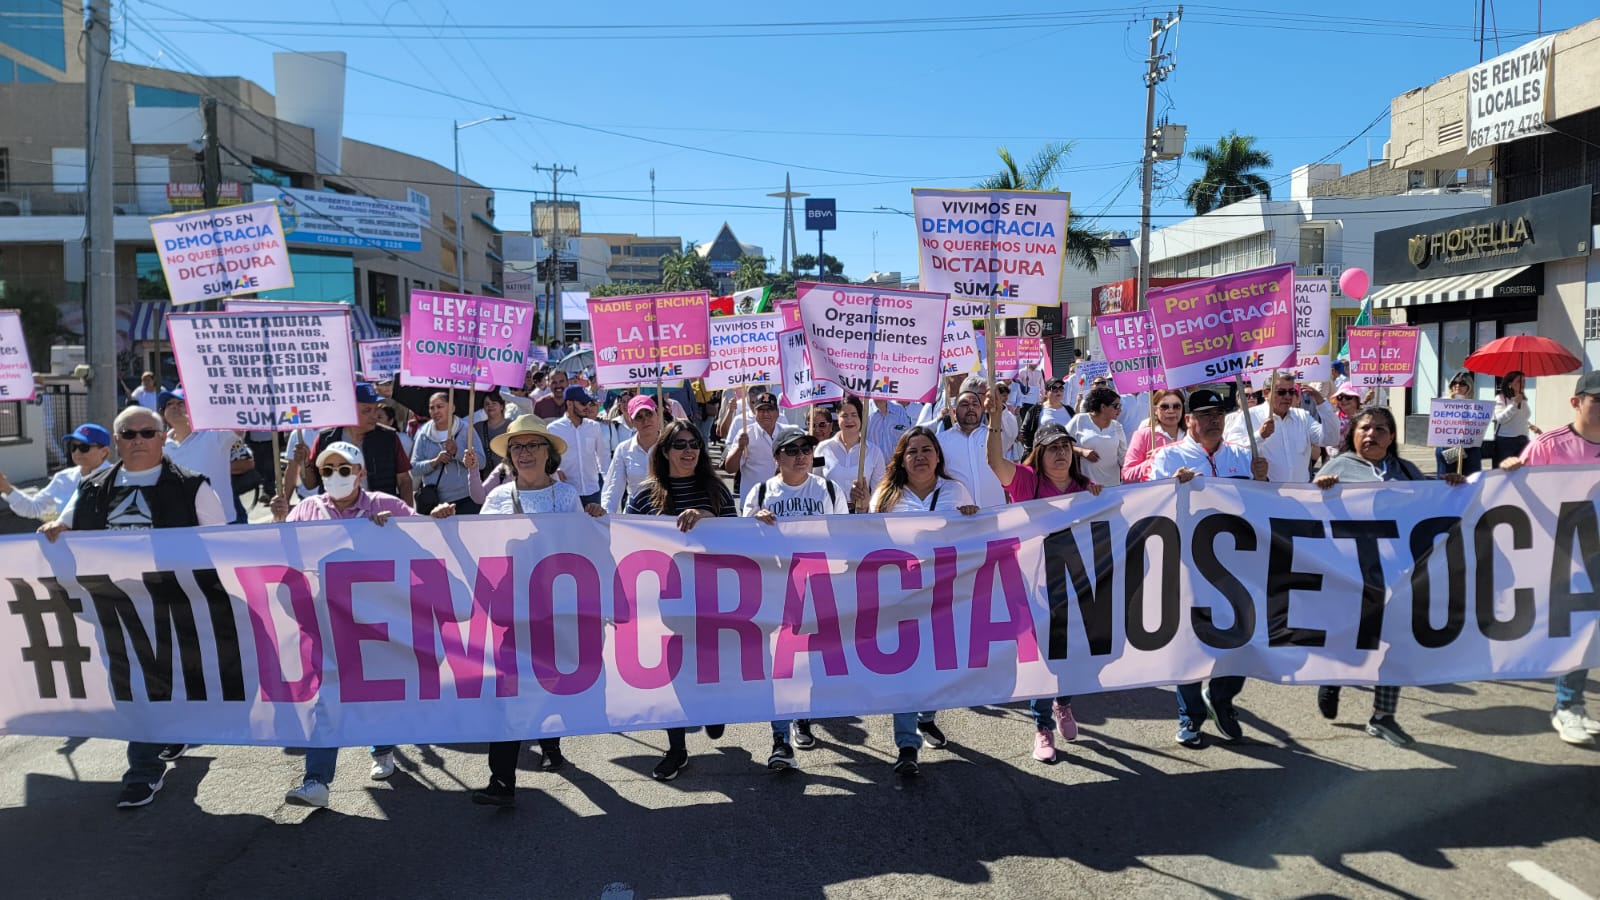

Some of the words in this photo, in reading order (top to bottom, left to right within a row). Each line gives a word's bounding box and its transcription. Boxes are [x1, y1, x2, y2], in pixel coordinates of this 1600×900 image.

[1472, 69, 1488, 93] SE
[1493, 45, 1550, 86] RENTAN
[1478, 79, 1541, 118] LOCALES
[1471, 126, 1490, 148] 667
[1494, 120, 1515, 142] 372
[943, 201, 1010, 215] VIVIMOS
[1015, 203, 1037, 216] EN
[176, 217, 233, 232] VIVIMOS
[236, 213, 253, 225] EN
[922, 218, 1055, 237] DEMOCRACIA
[164, 224, 274, 251] DEMOCRACIA
[1430, 216, 1528, 256] FIORELLA
[167, 255, 185, 265] NO
[188, 245, 250, 263] QUEREMOS
[252, 240, 279, 251] UNA
[922, 238, 939, 249] NO
[943, 239, 1021, 253] QUEREMOS
[1025, 243, 1057, 254] UNA
[178, 255, 275, 280] DICTADURA
[931, 255, 1045, 276] DICTADURA
[594, 301, 632, 313] NADIE
[635, 302, 654, 312] por
[655, 296, 704, 309] ENCIMA
[832, 290, 913, 309] Queremos
[1165, 296, 1199, 314] Por
[1204, 280, 1281, 305] nuestra
[418, 300, 430, 311] la
[432, 296, 467, 317] LEY
[467, 308, 477, 316] es
[480, 307, 490, 318] la
[494, 304, 526, 325] LEY
[644, 313, 656, 322] de
[825, 307, 916, 328] Organismos
[1160, 300, 1289, 338] DEMOCRACIA
[191, 316, 213, 330] LA
[219, 314, 322, 329] DICTADURA
[433, 317, 513, 339] RESPETO
[714, 321, 758, 332] VIVIMOS
[760, 320, 774, 329] EN
[1103, 325, 1113, 335] la
[1114, 315, 1144, 337] LEY
[195, 331, 232, 340] ENTRA
[236, 330, 260, 339] CON
[617, 326, 643, 343] LA
[647, 322, 687, 341] LEY.
[812, 323, 928, 346] Independientes
[957, 330, 971, 341] LA
[1181, 333, 1234, 356] Estoy
[1240, 322, 1276, 345] aquí
[1350, 329, 1373, 337] NADIE
[1388, 329, 1416, 337] ENCIMA
[197, 344, 214, 353] SE
[218, 342, 296, 353] CONSOLIDA
[301, 341, 330, 351] CON
[416, 340, 524, 364] CONSTITUCIÓN
[649, 344, 706, 359] DECIDE!
[720, 345, 768, 357] QUEREMOS
[826, 347, 878, 360] Defiendan
[881, 352, 889, 361] la
[892, 353, 935, 365] Libertad
[1360, 347, 1376, 359] LA
[1380, 347, 1400, 359] LEY.
[202, 355, 223, 366] LA
[228, 351, 327, 366] SUPRESIÓN
[1379, 363, 1411, 371] DECIDE!
[207, 367, 228, 378] DE
[873, 363, 919, 375] Derechos
[209, 384, 219, 394] Y
[224, 383, 244, 394] SE
[247, 380, 333, 395] MANTIENE
[209, 396, 236, 405] CON
[240, 395, 254, 405] LA
[257, 393, 336, 406] VIOLENCIA.
[1433, 410, 1490, 420] DEMOCRACIA
[769, 497, 825, 516] COLORADO
